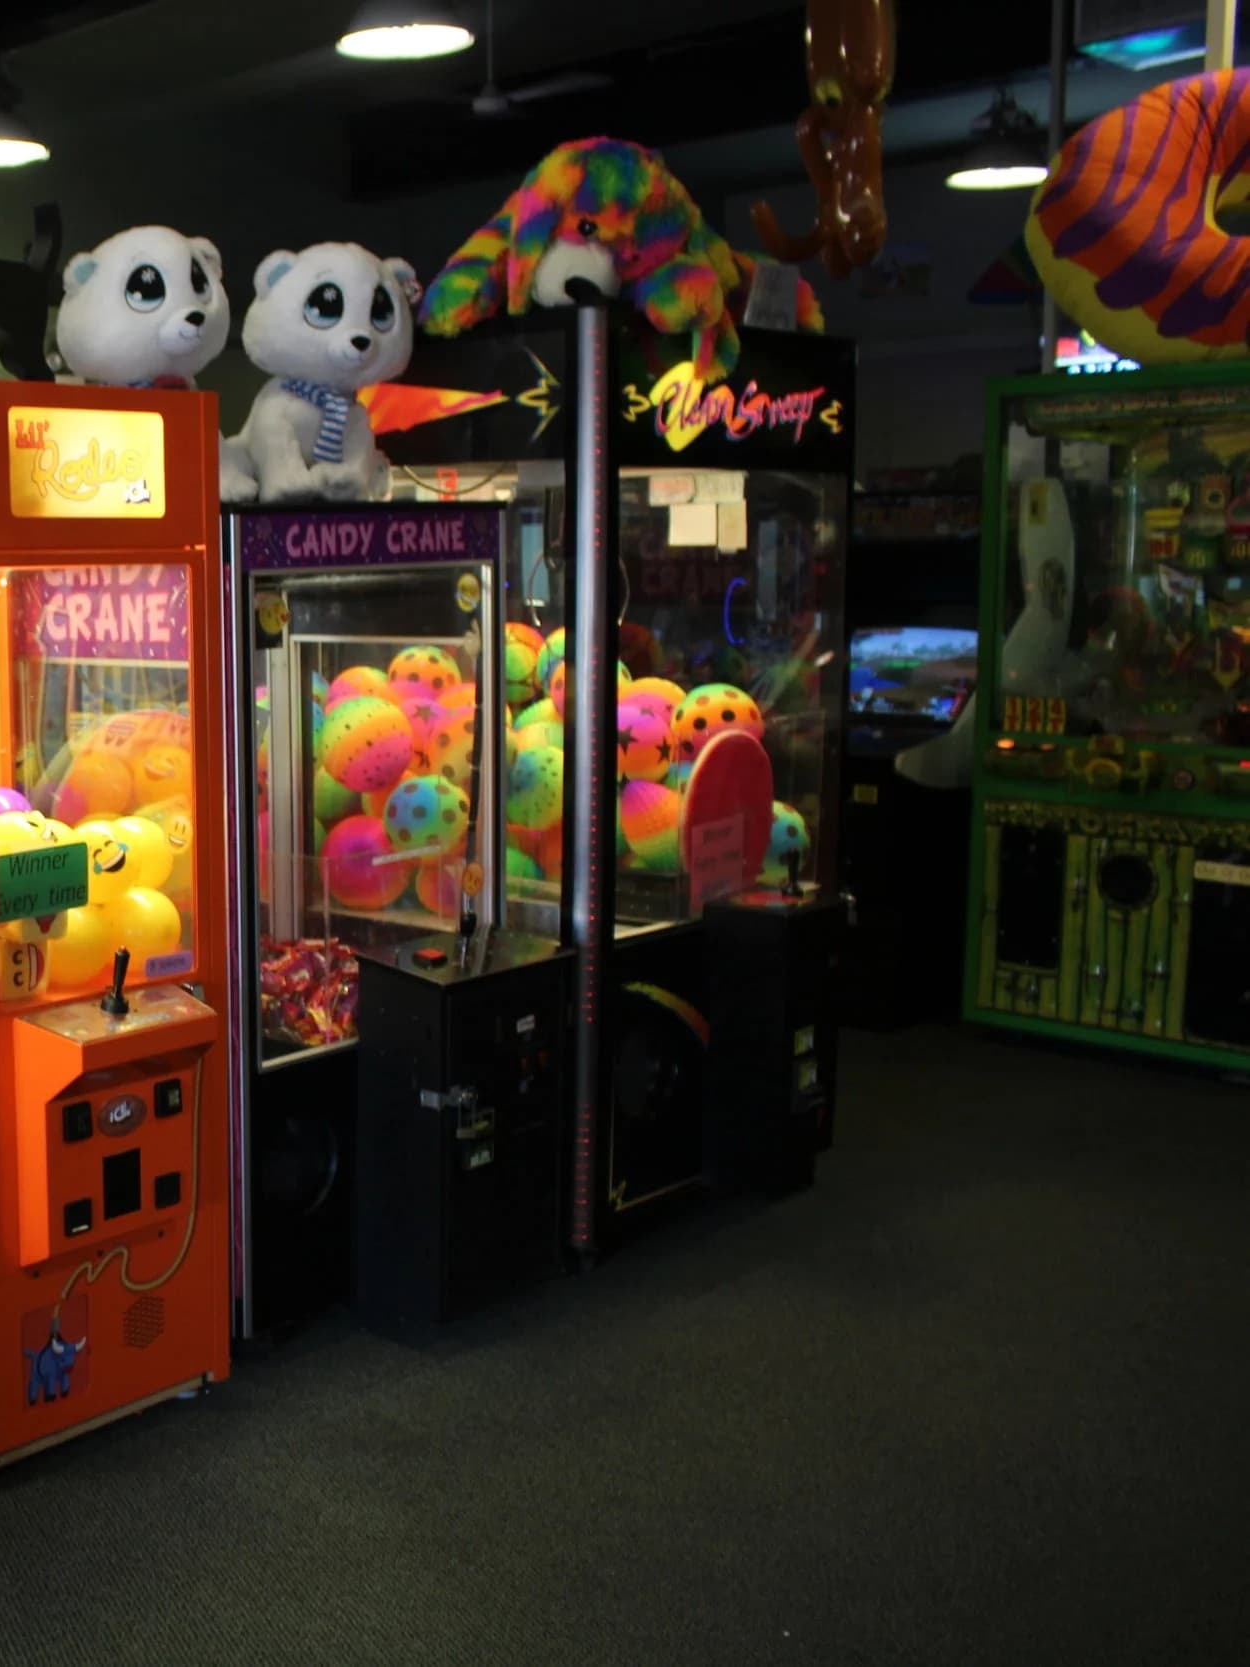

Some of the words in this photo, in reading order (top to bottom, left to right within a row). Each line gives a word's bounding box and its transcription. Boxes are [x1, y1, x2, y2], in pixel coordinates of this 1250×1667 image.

[31, 436, 144, 502] Rodeo
[285, 520, 375, 559] CANDY
[385, 517, 467, 553] CRANE
[44, 591, 172, 644] CRANE
[8, 850, 71, 878] Winner
[49, 882, 87, 905] time
